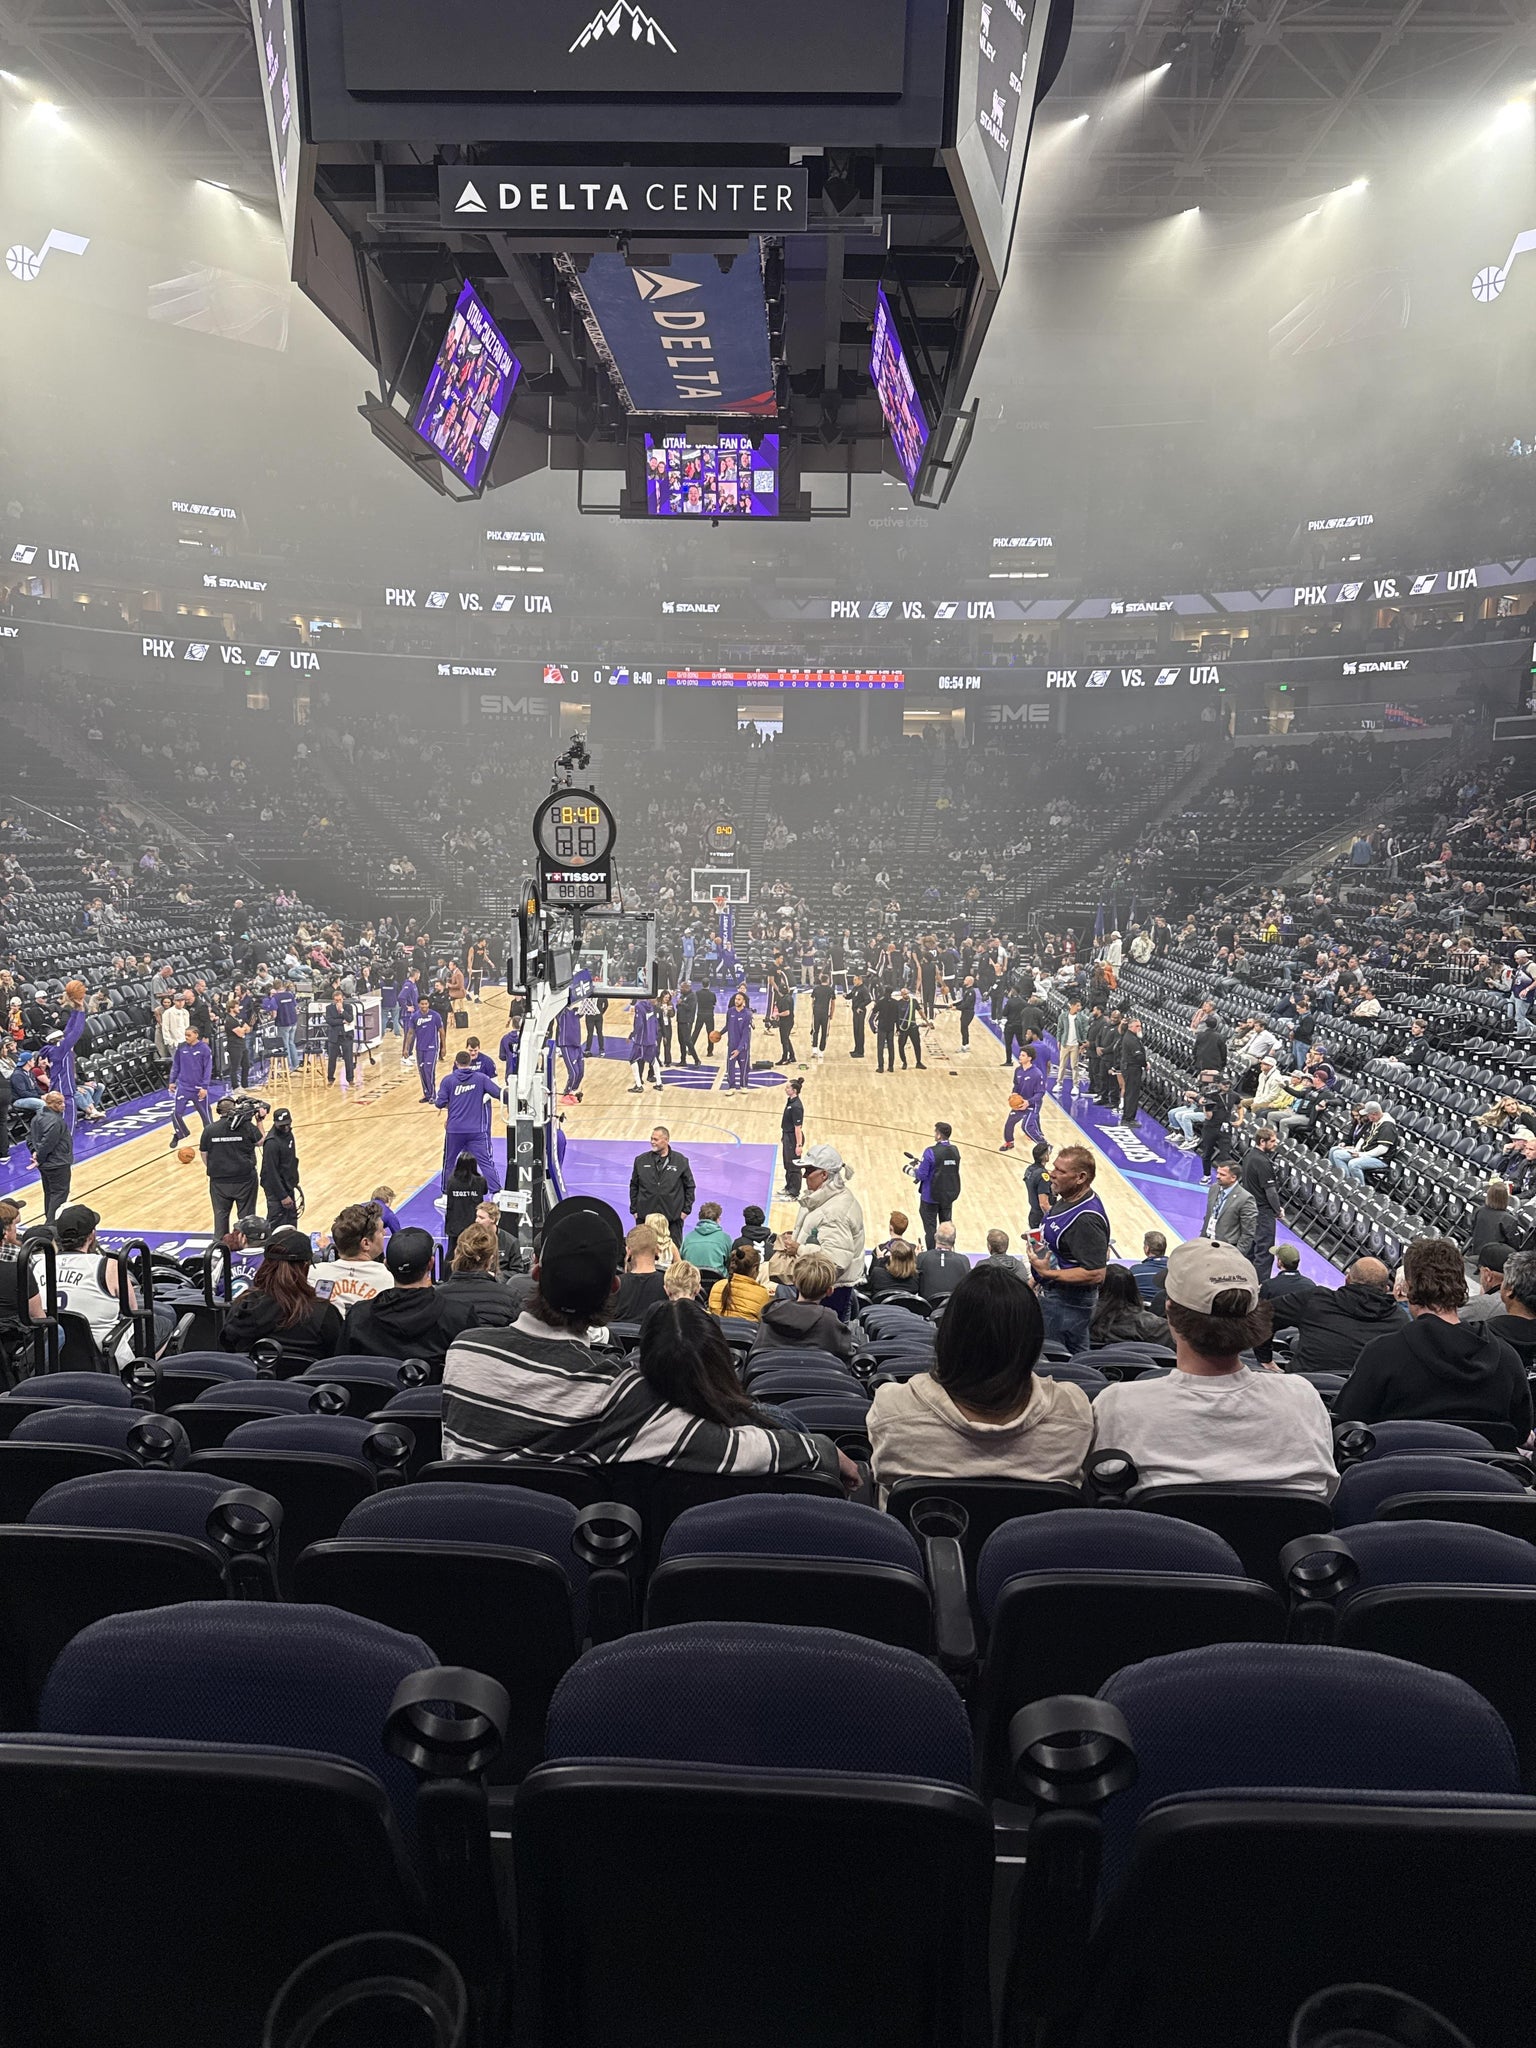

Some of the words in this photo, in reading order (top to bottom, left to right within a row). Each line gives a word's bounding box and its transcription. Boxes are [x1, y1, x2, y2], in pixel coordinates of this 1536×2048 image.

[980, 110, 1009, 152] STANLEY
[499, 183, 629, 211] DELTA
[645, 183, 794, 212] CENTER
[652, 311, 723, 399] DELTA
[663, 438, 686, 449] UTAH
[720, 438, 738, 449] FAN
[740, 438, 753, 449] CA
[172, 501, 189, 513] PHX
[220, 508, 236, 518] UTA
[1308, 520, 1325, 531] PHX
[1357, 515, 1374, 526] UTA
[487, 530, 502, 541] PHX
[530, 533, 545, 542] UTA
[993, 537, 1009, 547] PHX
[1037, 537, 1053, 547] UTA
[48, 549, 80, 572] UTA
[219, 578, 267, 591] STANLEY
[1294, 585, 1327, 606] PHX
[1374, 578, 1400, 598] VS.
[1447, 568, 1478, 590] UTA
[385, 588, 416, 607] PHX
[459, 592, 483, 611] VS.
[525, 595, 552, 613] UTA
[676, 603, 720, 613] STANLEY
[1125, 601, 1174, 613] STANLEY
[831, 601, 860, 618] PHX
[902, 601, 926, 619] VS.
[967, 602, 995, 619] UTA
[142, 638, 175, 659] PHX
[220, 645, 246, 665] VS.
[290, 651, 320, 670] UTA
[452, 666, 497, 677] STANLEY
[1358, 660, 1409, 673] STANLEY
[571, 670, 579, 683] 0
[594, 671, 602, 684] 0
[633, 671, 652, 685] 8:40
[939, 676, 963, 689] 06:54
[965, 676, 981, 689] PM
[1046, 670, 1077, 688] PHX
[1121, 669, 1145, 687] VS.
[1190, 666, 1219, 684] UTA
[480, 695, 548, 715] SME
[984, 704, 1050, 722] SME
[561, 806, 600, 824] 8:40
[562, 873, 606, 882] TISSOT
[454, 1084, 476, 1096] UTAH
[102, 1099, 194, 1129] PACS
[40, 1270, 84, 1287] CLIER
[230, 1265, 258, 1281] NGLE
[331, 1279, 378, 1299] OOKER
